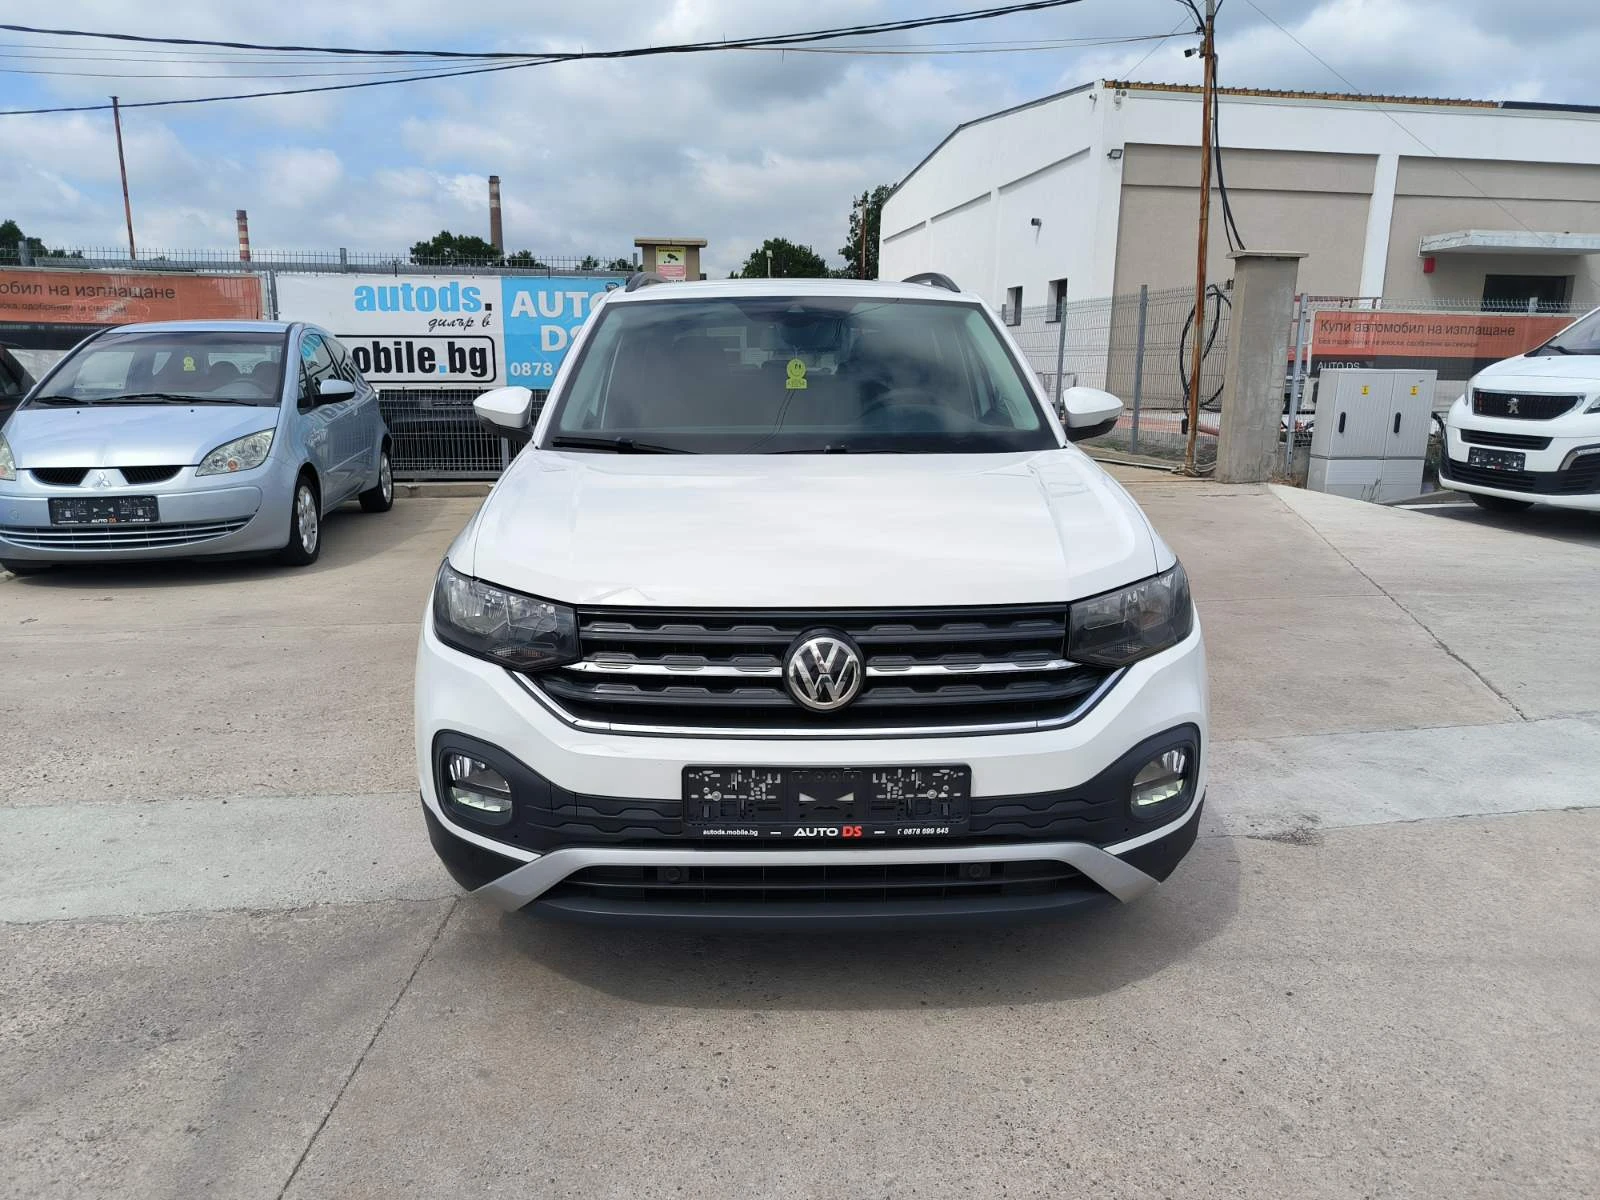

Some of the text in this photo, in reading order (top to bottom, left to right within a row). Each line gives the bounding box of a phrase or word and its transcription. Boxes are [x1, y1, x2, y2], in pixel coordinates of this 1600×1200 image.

[48, 284, 69, 296] на
[75, 286, 176, 299] изплащане
[354, 281, 493, 312] autods.
[428, 317, 475, 332] дилър
[1320, 320, 1516, 337] Купи автомобил на изплащане
[541, 324, 585, 352] D
[351, 341, 487, 377] obile.bg
[1317, 361, 1344, 370] AUTO
[510, 362, 553, 376] 0878
[793, 825, 863, 837] AUTO DS
